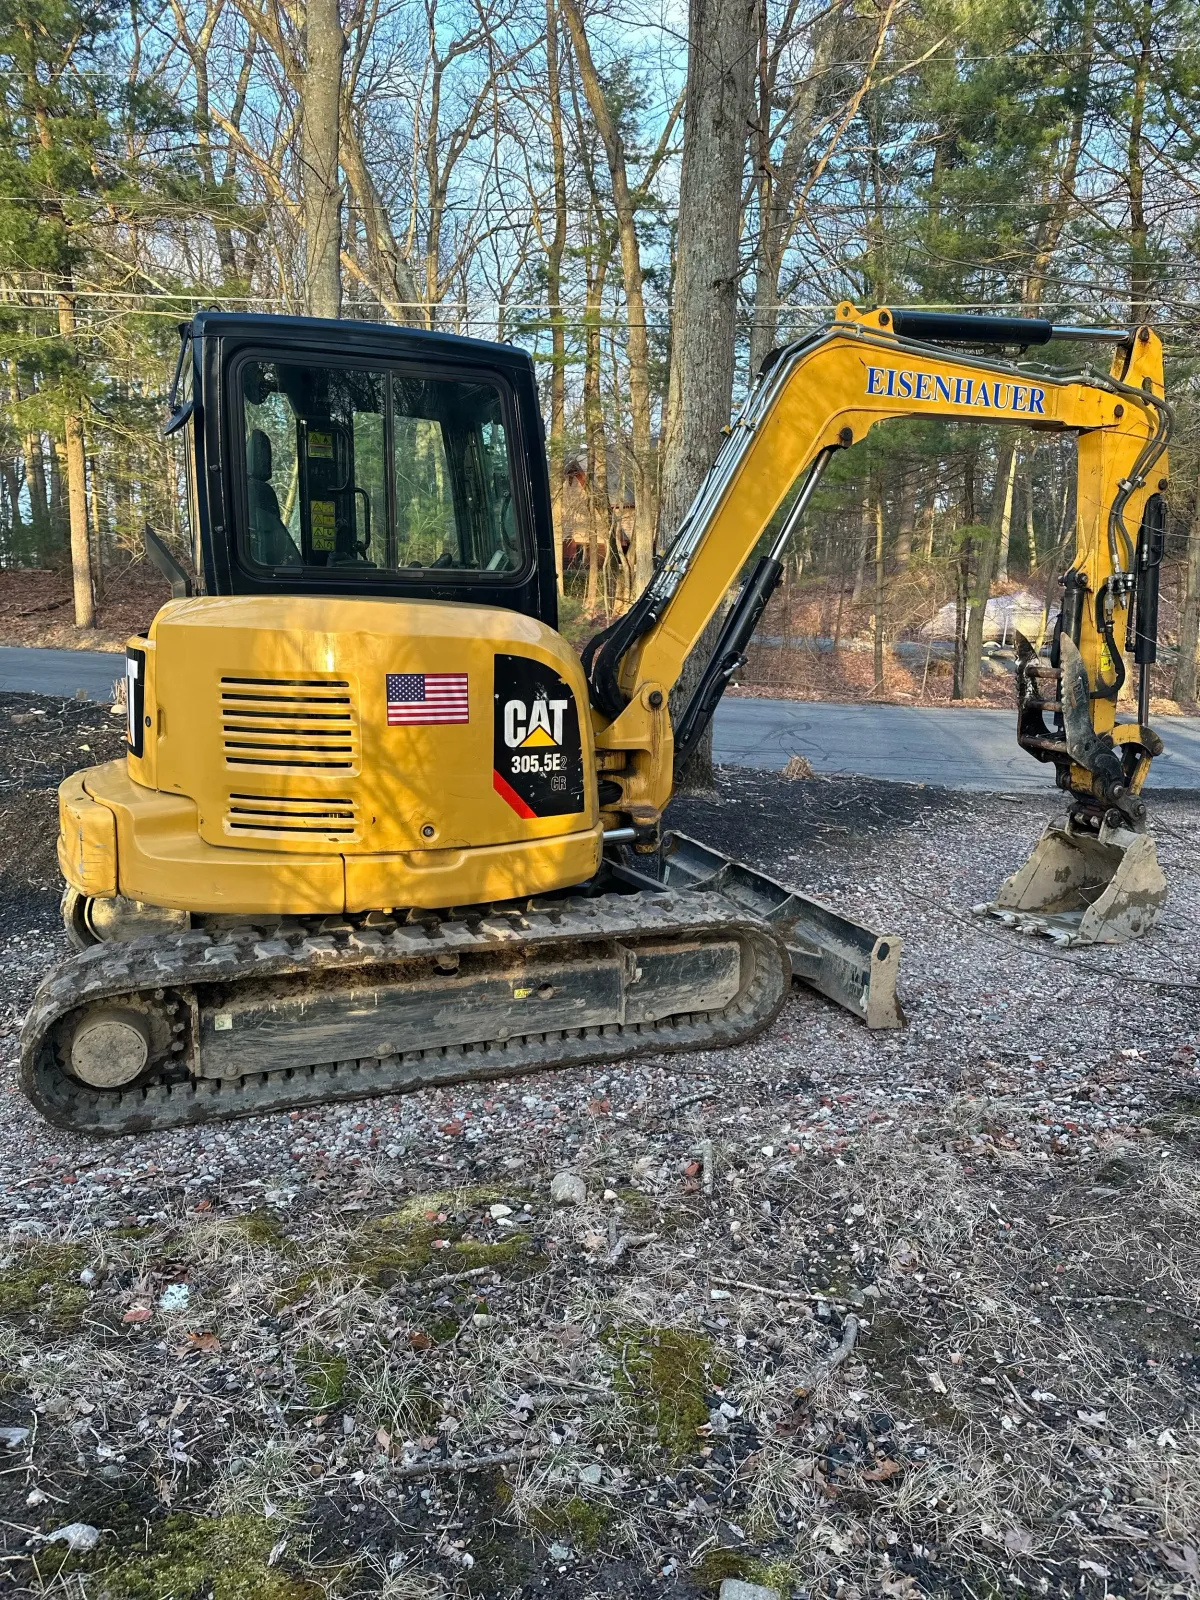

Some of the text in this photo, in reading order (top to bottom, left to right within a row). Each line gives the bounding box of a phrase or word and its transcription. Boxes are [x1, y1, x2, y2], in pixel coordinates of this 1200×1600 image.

[866, 367, 1046, 414] EISENHAUER
[504, 699, 568, 748] CAT
[551, 776, 567, 791] CR
